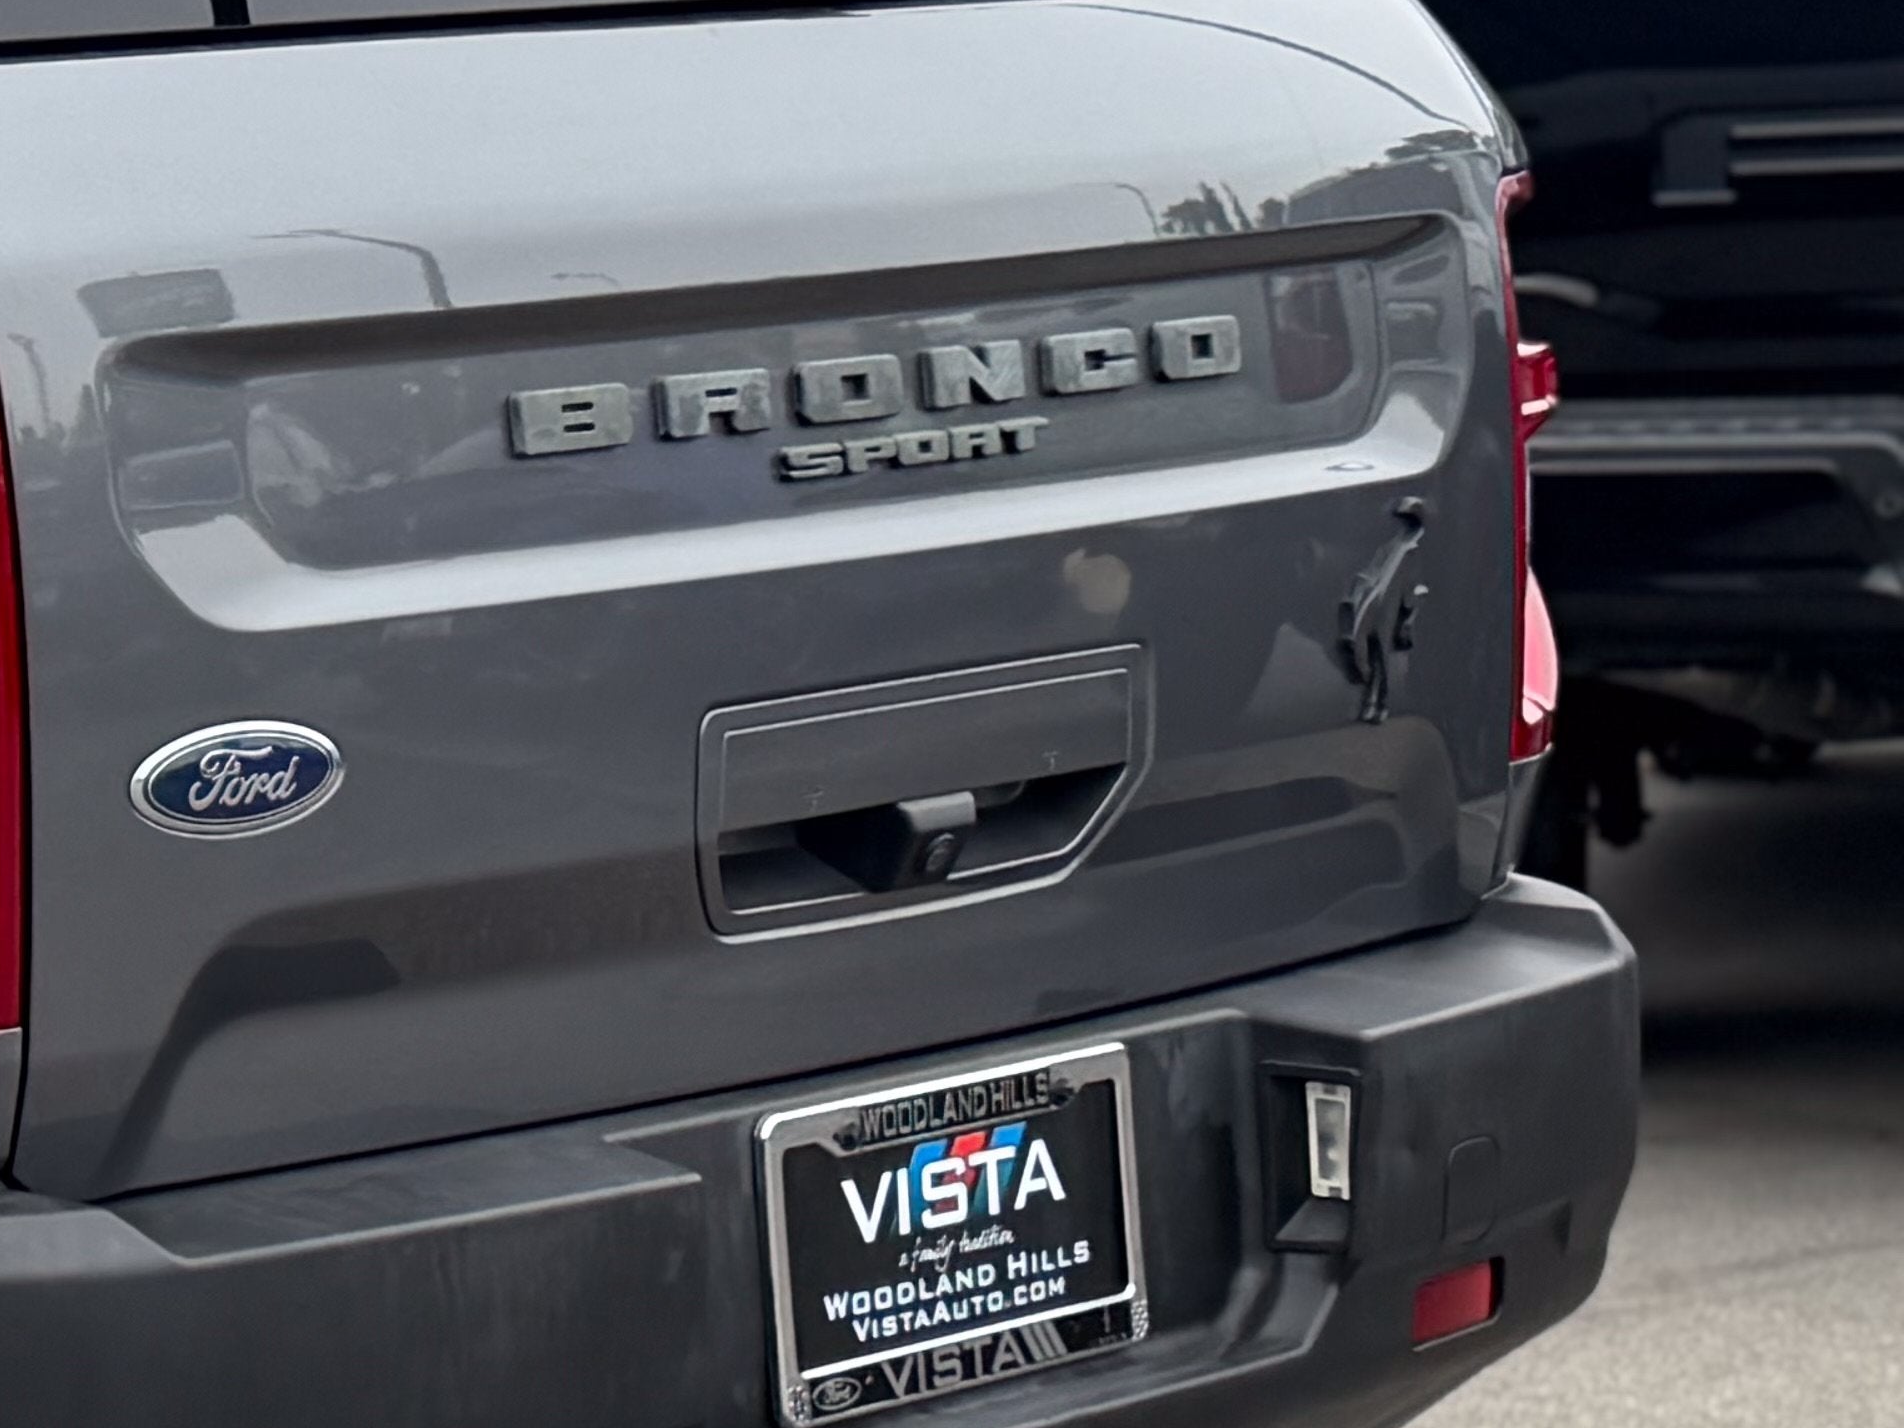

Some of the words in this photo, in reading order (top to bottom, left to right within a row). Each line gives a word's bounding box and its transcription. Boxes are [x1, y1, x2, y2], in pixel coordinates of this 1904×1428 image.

[508, 315, 1241, 456] BRONCO
[775, 416, 1048, 481] SPORT
[188, 745, 300, 811] Ford
[861, 1085, 988, 1142] WOODLAND
[989, 1072, 1050, 1112] HILLS
[840, 1138, 1067, 1244] VISTA
[881, 1327, 1026, 1400] VISTA
